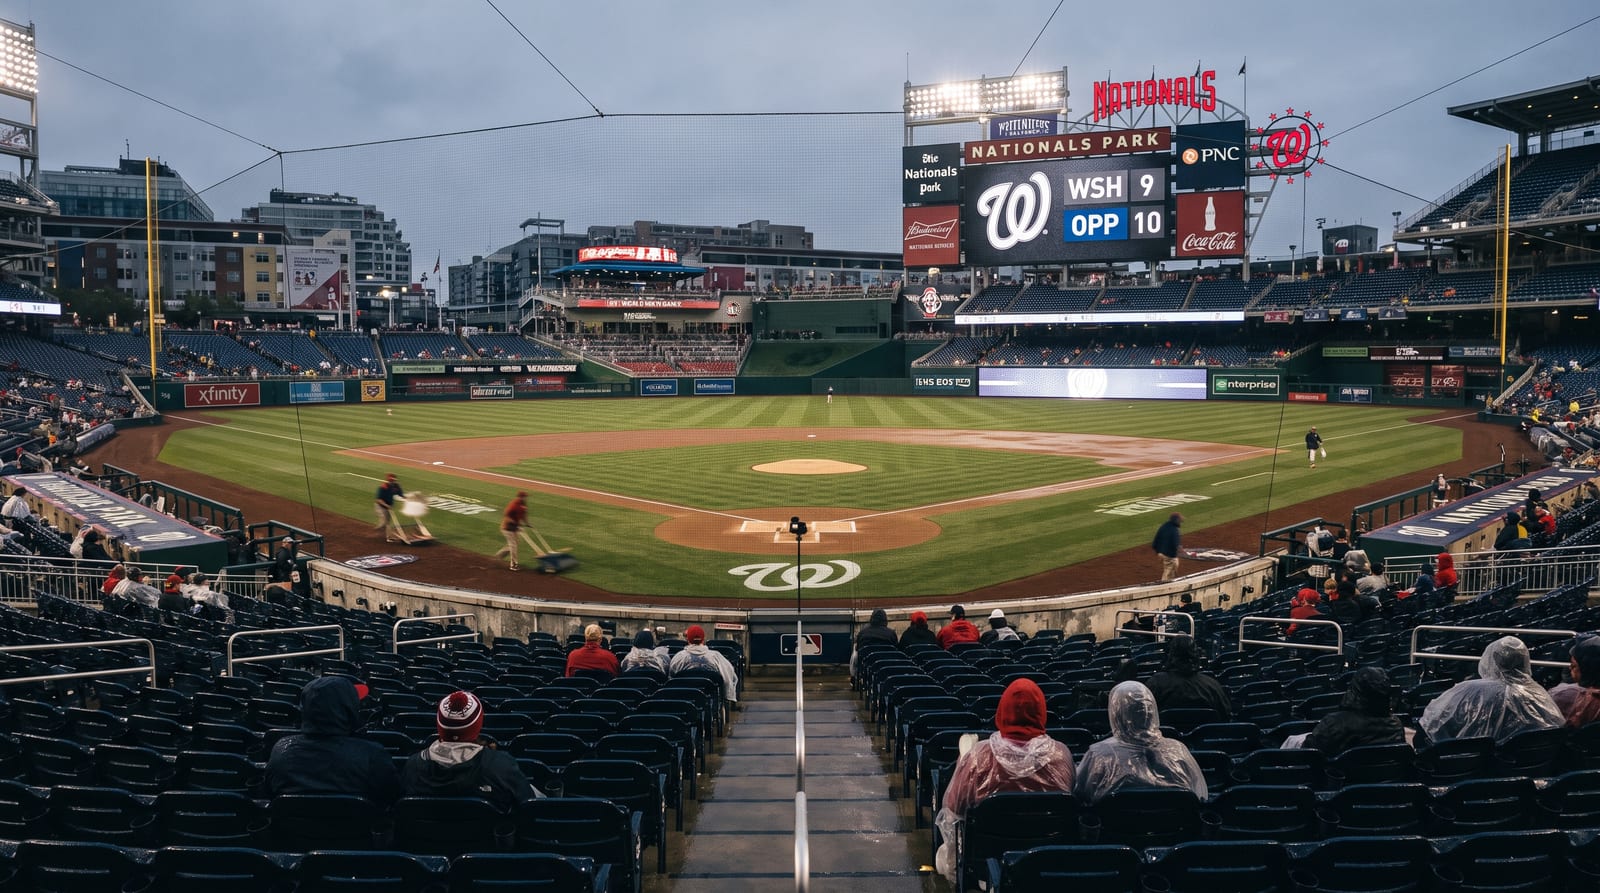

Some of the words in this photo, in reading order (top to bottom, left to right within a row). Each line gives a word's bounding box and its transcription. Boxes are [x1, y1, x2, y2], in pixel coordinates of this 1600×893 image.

[1093, 70, 1216, 123] NATIONALS
[972, 138, 1092, 158] NATIONALS
[1102, 132, 1159, 150] PARK
[1201, 146, 1241, 163] PNC
[905, 165, 958, 179] Nationals
[1067, 175, 1122, 200] WSH
[1140, 174, 1154, 197] 9
[1071, 213, 1119, 237] OPP
[1134, 211, 1161, 234] 10
[1182, 231, 1239, 251] Coca-Cola
[199, 386, 248, 404] xfinity
